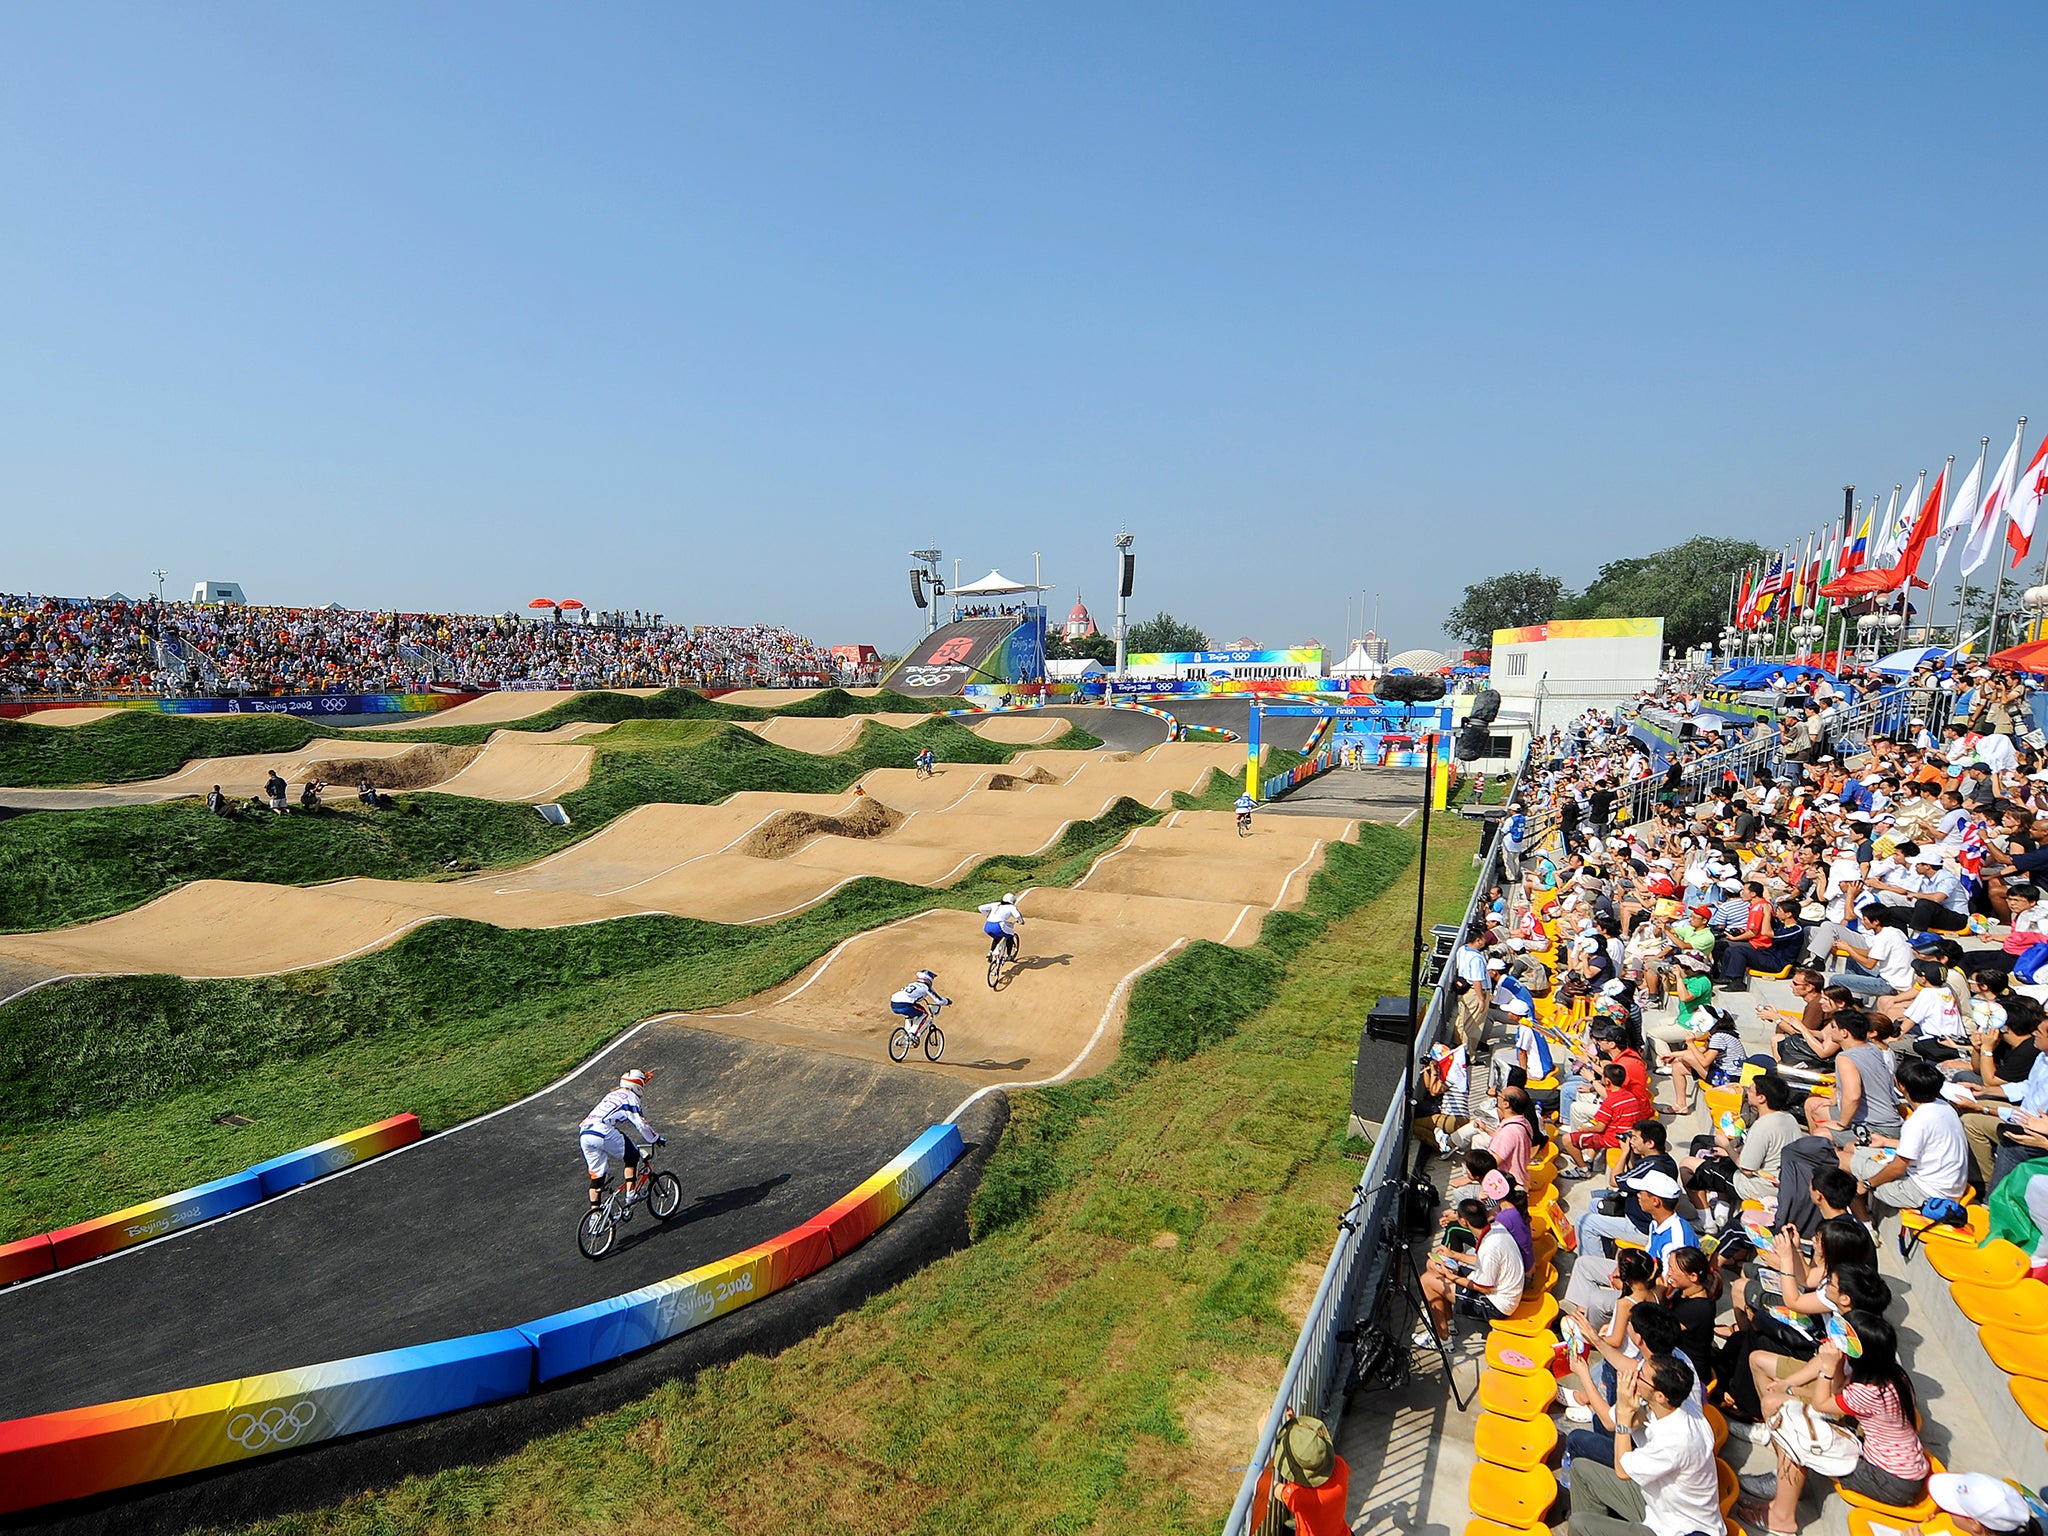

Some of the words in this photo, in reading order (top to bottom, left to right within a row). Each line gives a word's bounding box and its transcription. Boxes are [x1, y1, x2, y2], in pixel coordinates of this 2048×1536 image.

[1207, 653, 1230, 662] Beijing
[905, 665, 942, 674] Beijing
[1117, 683, 1136, 691] Beijing
[251, 700, 288, 713] Beijing
[288, 700, 313, 710] 2008
[123, 1218, 170, 1238] Beijing
[171, 1206, 202, 1224] 2008
[658, 1289, 715, 1324] Beijing
[715, 1271, 754, 1302] 2008
